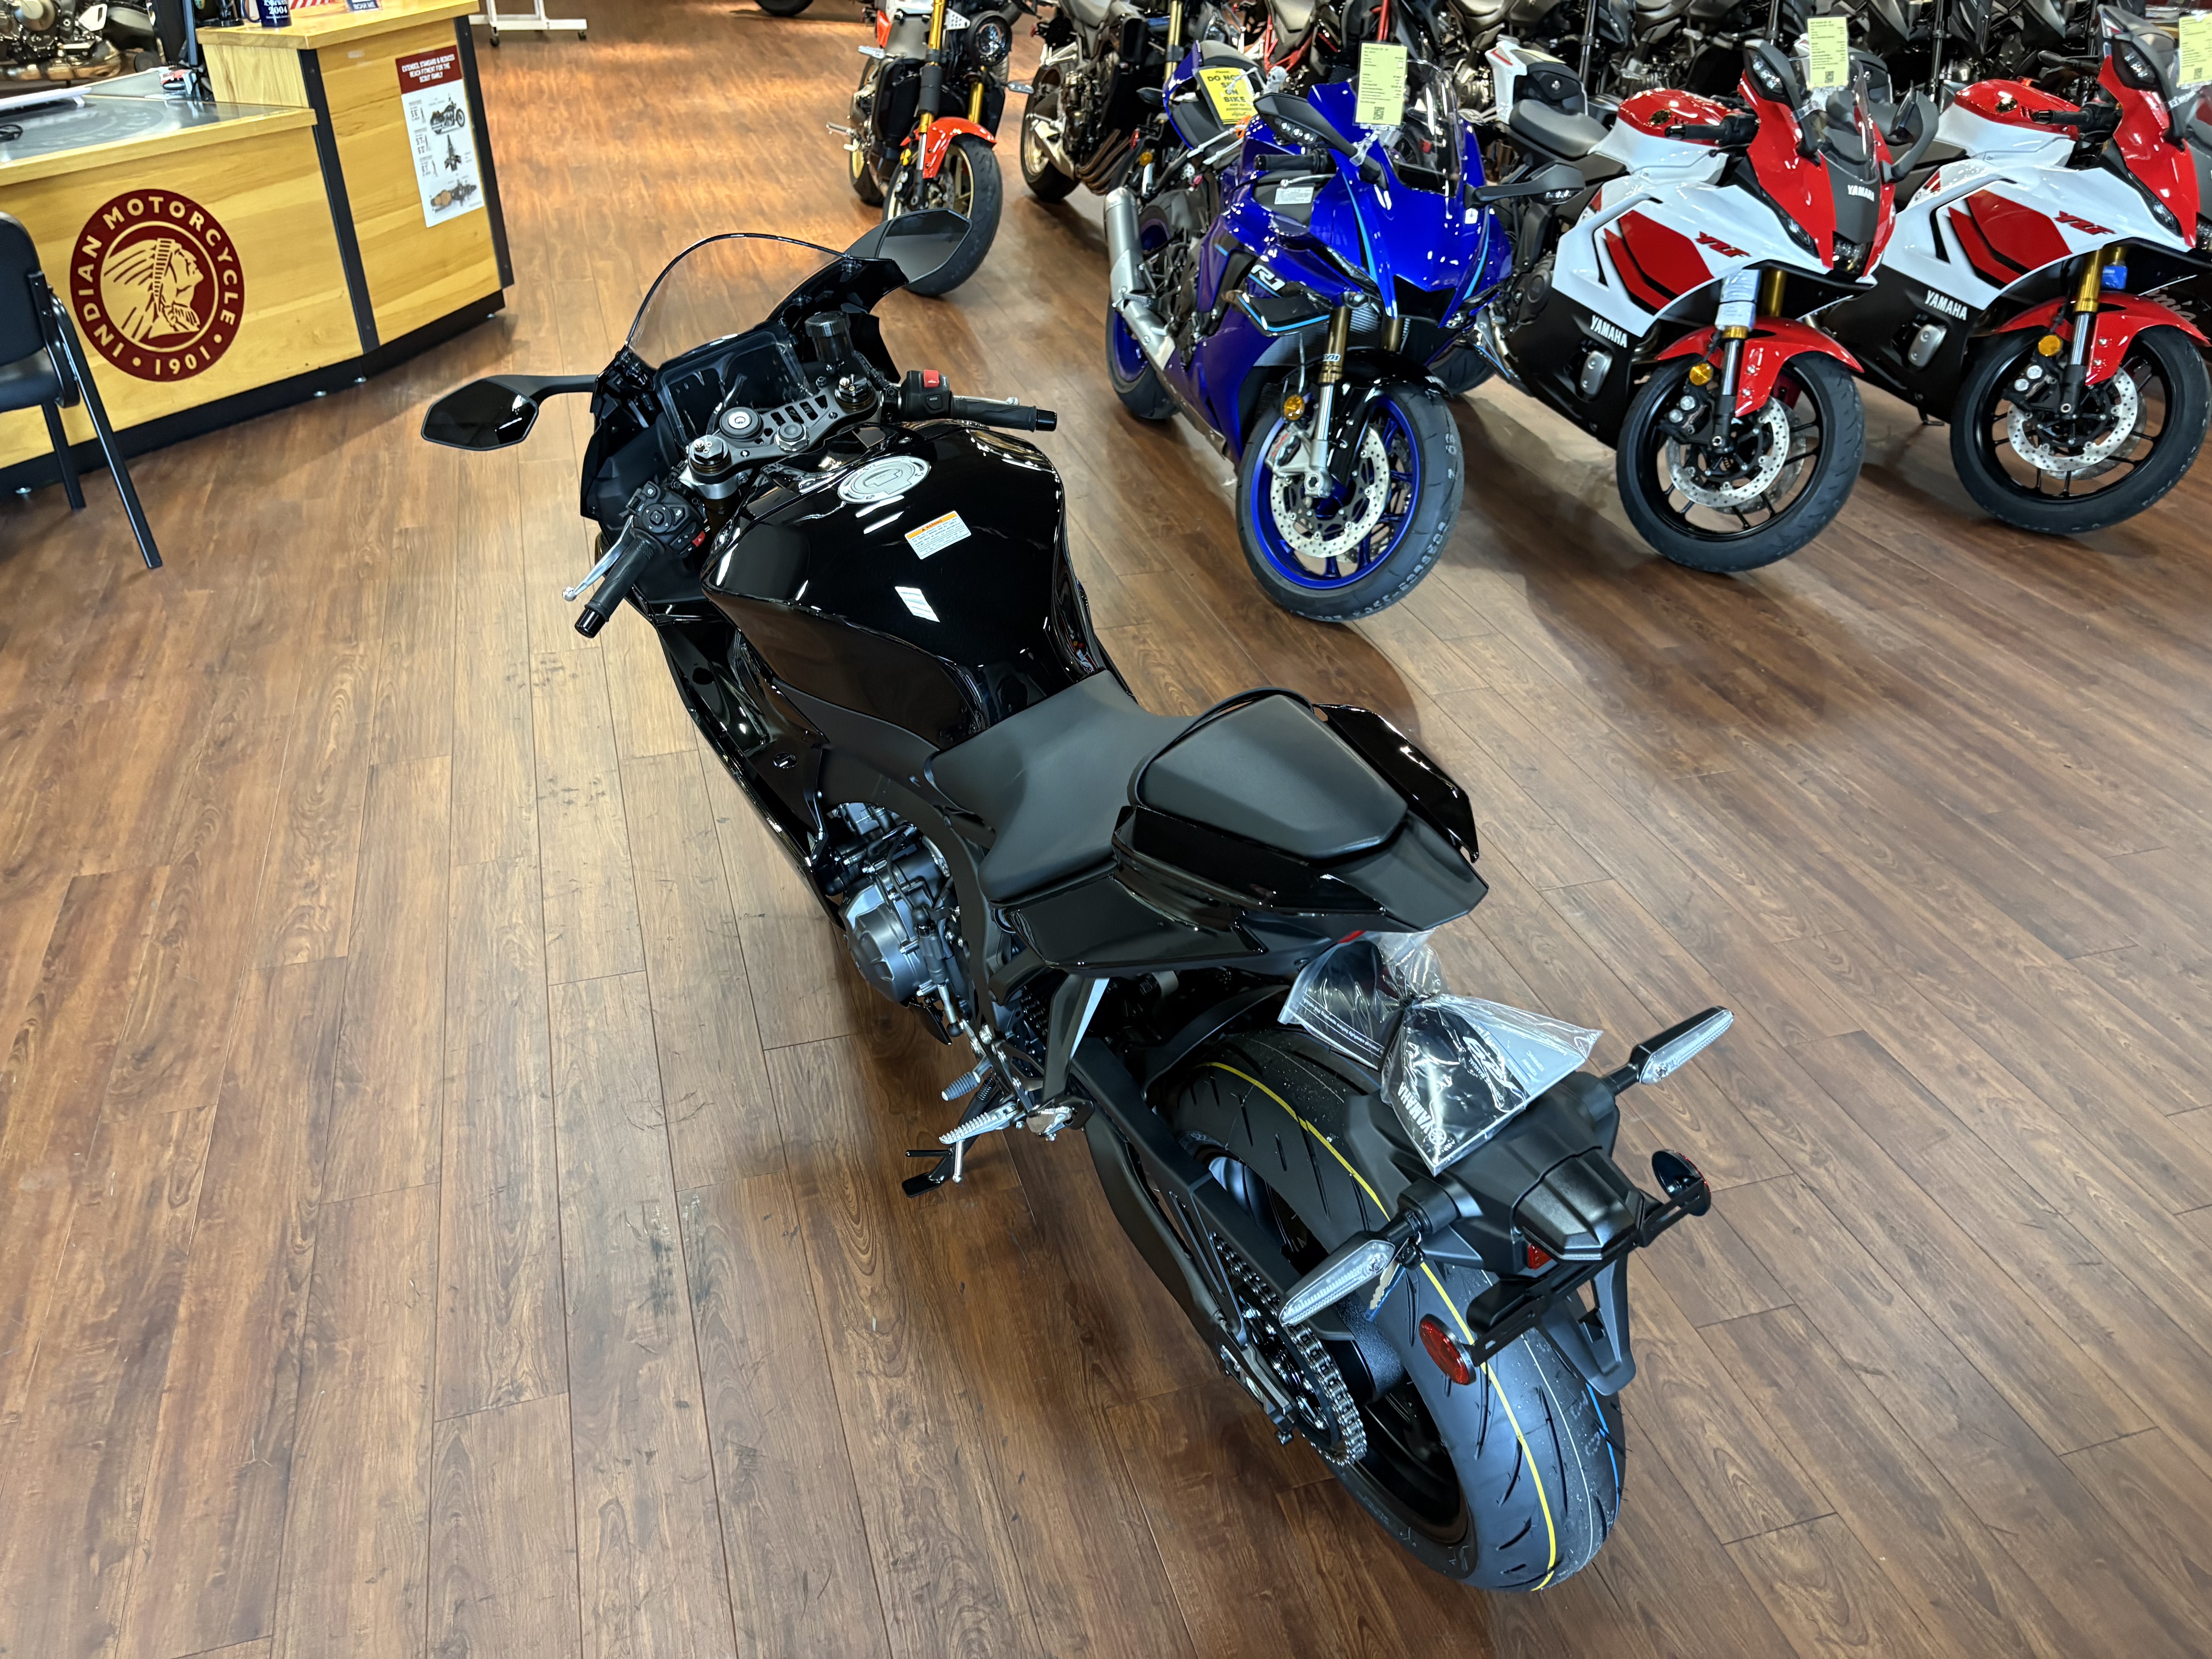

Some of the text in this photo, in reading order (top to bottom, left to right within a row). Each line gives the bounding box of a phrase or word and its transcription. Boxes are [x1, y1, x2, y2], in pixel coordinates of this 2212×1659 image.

[1847, 185, 1875, 202] YAMAHA
[77, 196, 239, 357] INDIAN MOTORCYCLE
[1925, 290, 1968, 321] YAMAHA
[1590, 315, 1628, 348] YAMAHA
[156, 345, 211, 375] 1901
[1397, 1081, 1435, 1133] YAMAHA
